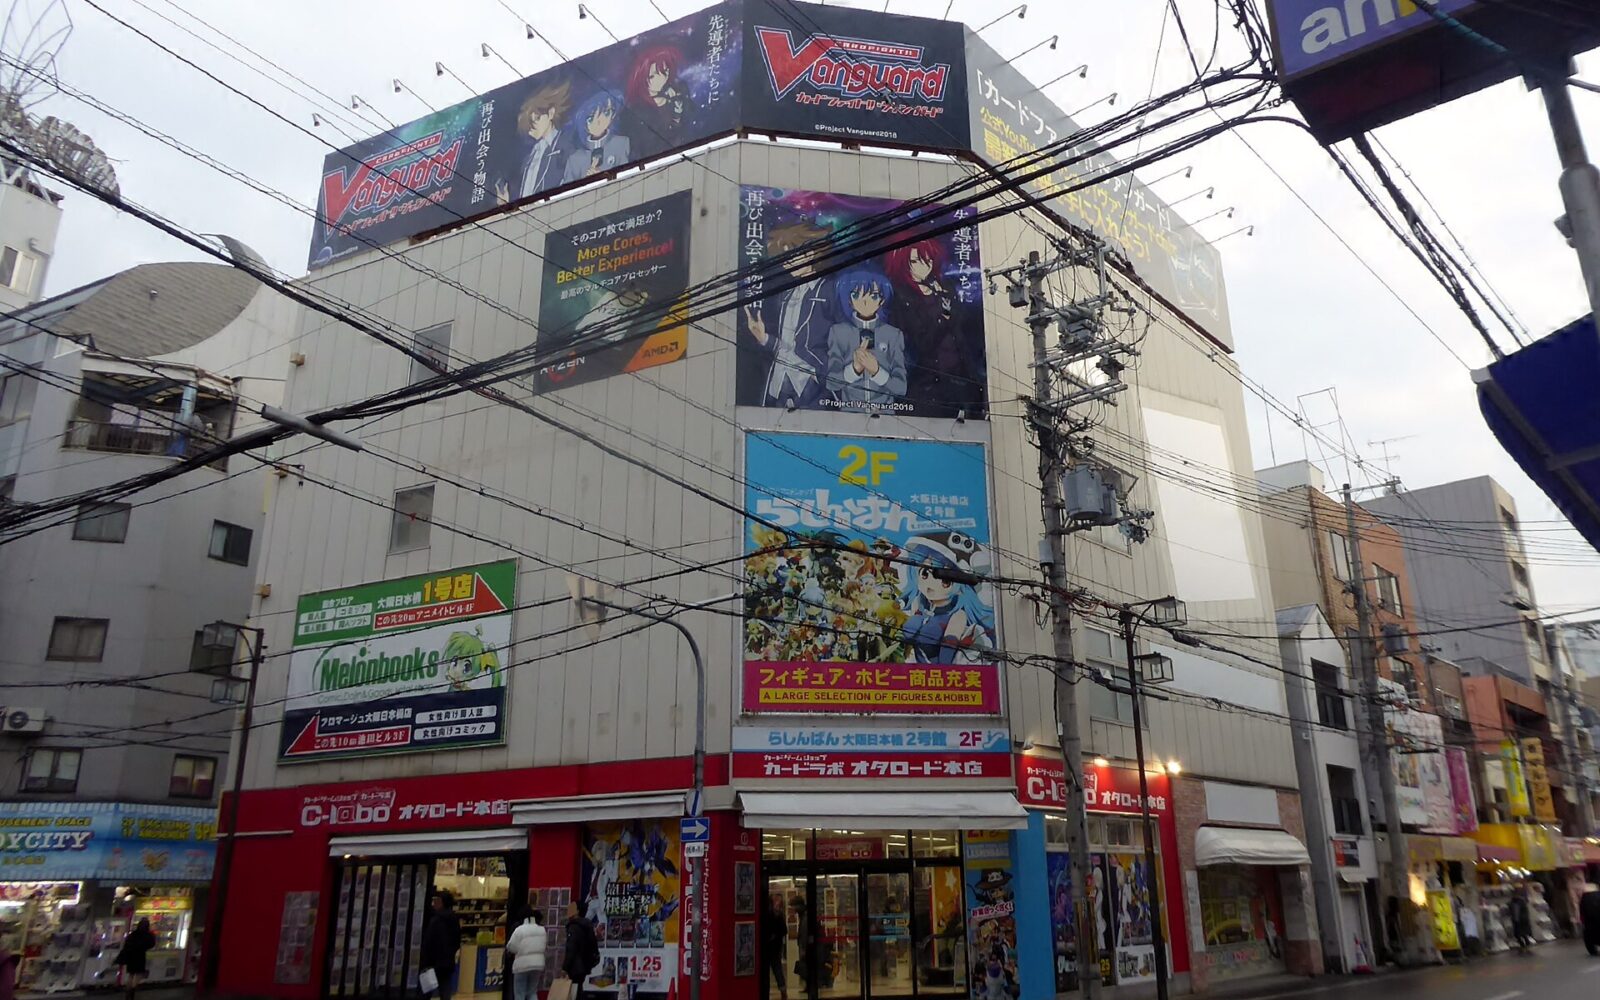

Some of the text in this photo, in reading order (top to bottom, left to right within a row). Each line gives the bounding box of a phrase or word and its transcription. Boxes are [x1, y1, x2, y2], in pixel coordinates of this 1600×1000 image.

[707, 14, 725, 104] 先導者たちに
[758, 29, 946, 99] Vanguard
[847, 127, 898, 138] Vanguard2018
[471, 100, 495, 205] 再び出会う物語
[323, 139, 464, 235] Vanguard
[571, 209, 663, 246] そのコア数で満足か?
[556, 239, 675, 285] Better Experience!
[577, 244, 610, 263] More
[856, 401, 914, 411] Vanguard2018
[837, 444, 898, 486] 2F
[756, 488, 917, 532] らしんばん
[377, 573, 474, 610] 大阪日本橋 1号店
[319, 647, 440, 692] Melonbooks
[759, 667, 982, 688] フィギュア・ホビー商品充実
[763, 691, 770, 701] A
[775, 691, 809, 701] LARGE
[814, 691, 871, 702] SELECTION
[875, 692, 888, 702] OF
[321, 708, 412, 727] フロマージュ大阪日本橋店
[423, 724, 486, 738] 女性向けコミック
[768, 731, 982, 747] らしんばん 大阪日本橋 2号館 2F
[763, 760, 982, 775] カードラボ オタロード本店
[398, 800, 509, 820] オタロード本店
[56, 817, 91, 827] SPACE
[630, 955, 662, 971] 1.25
